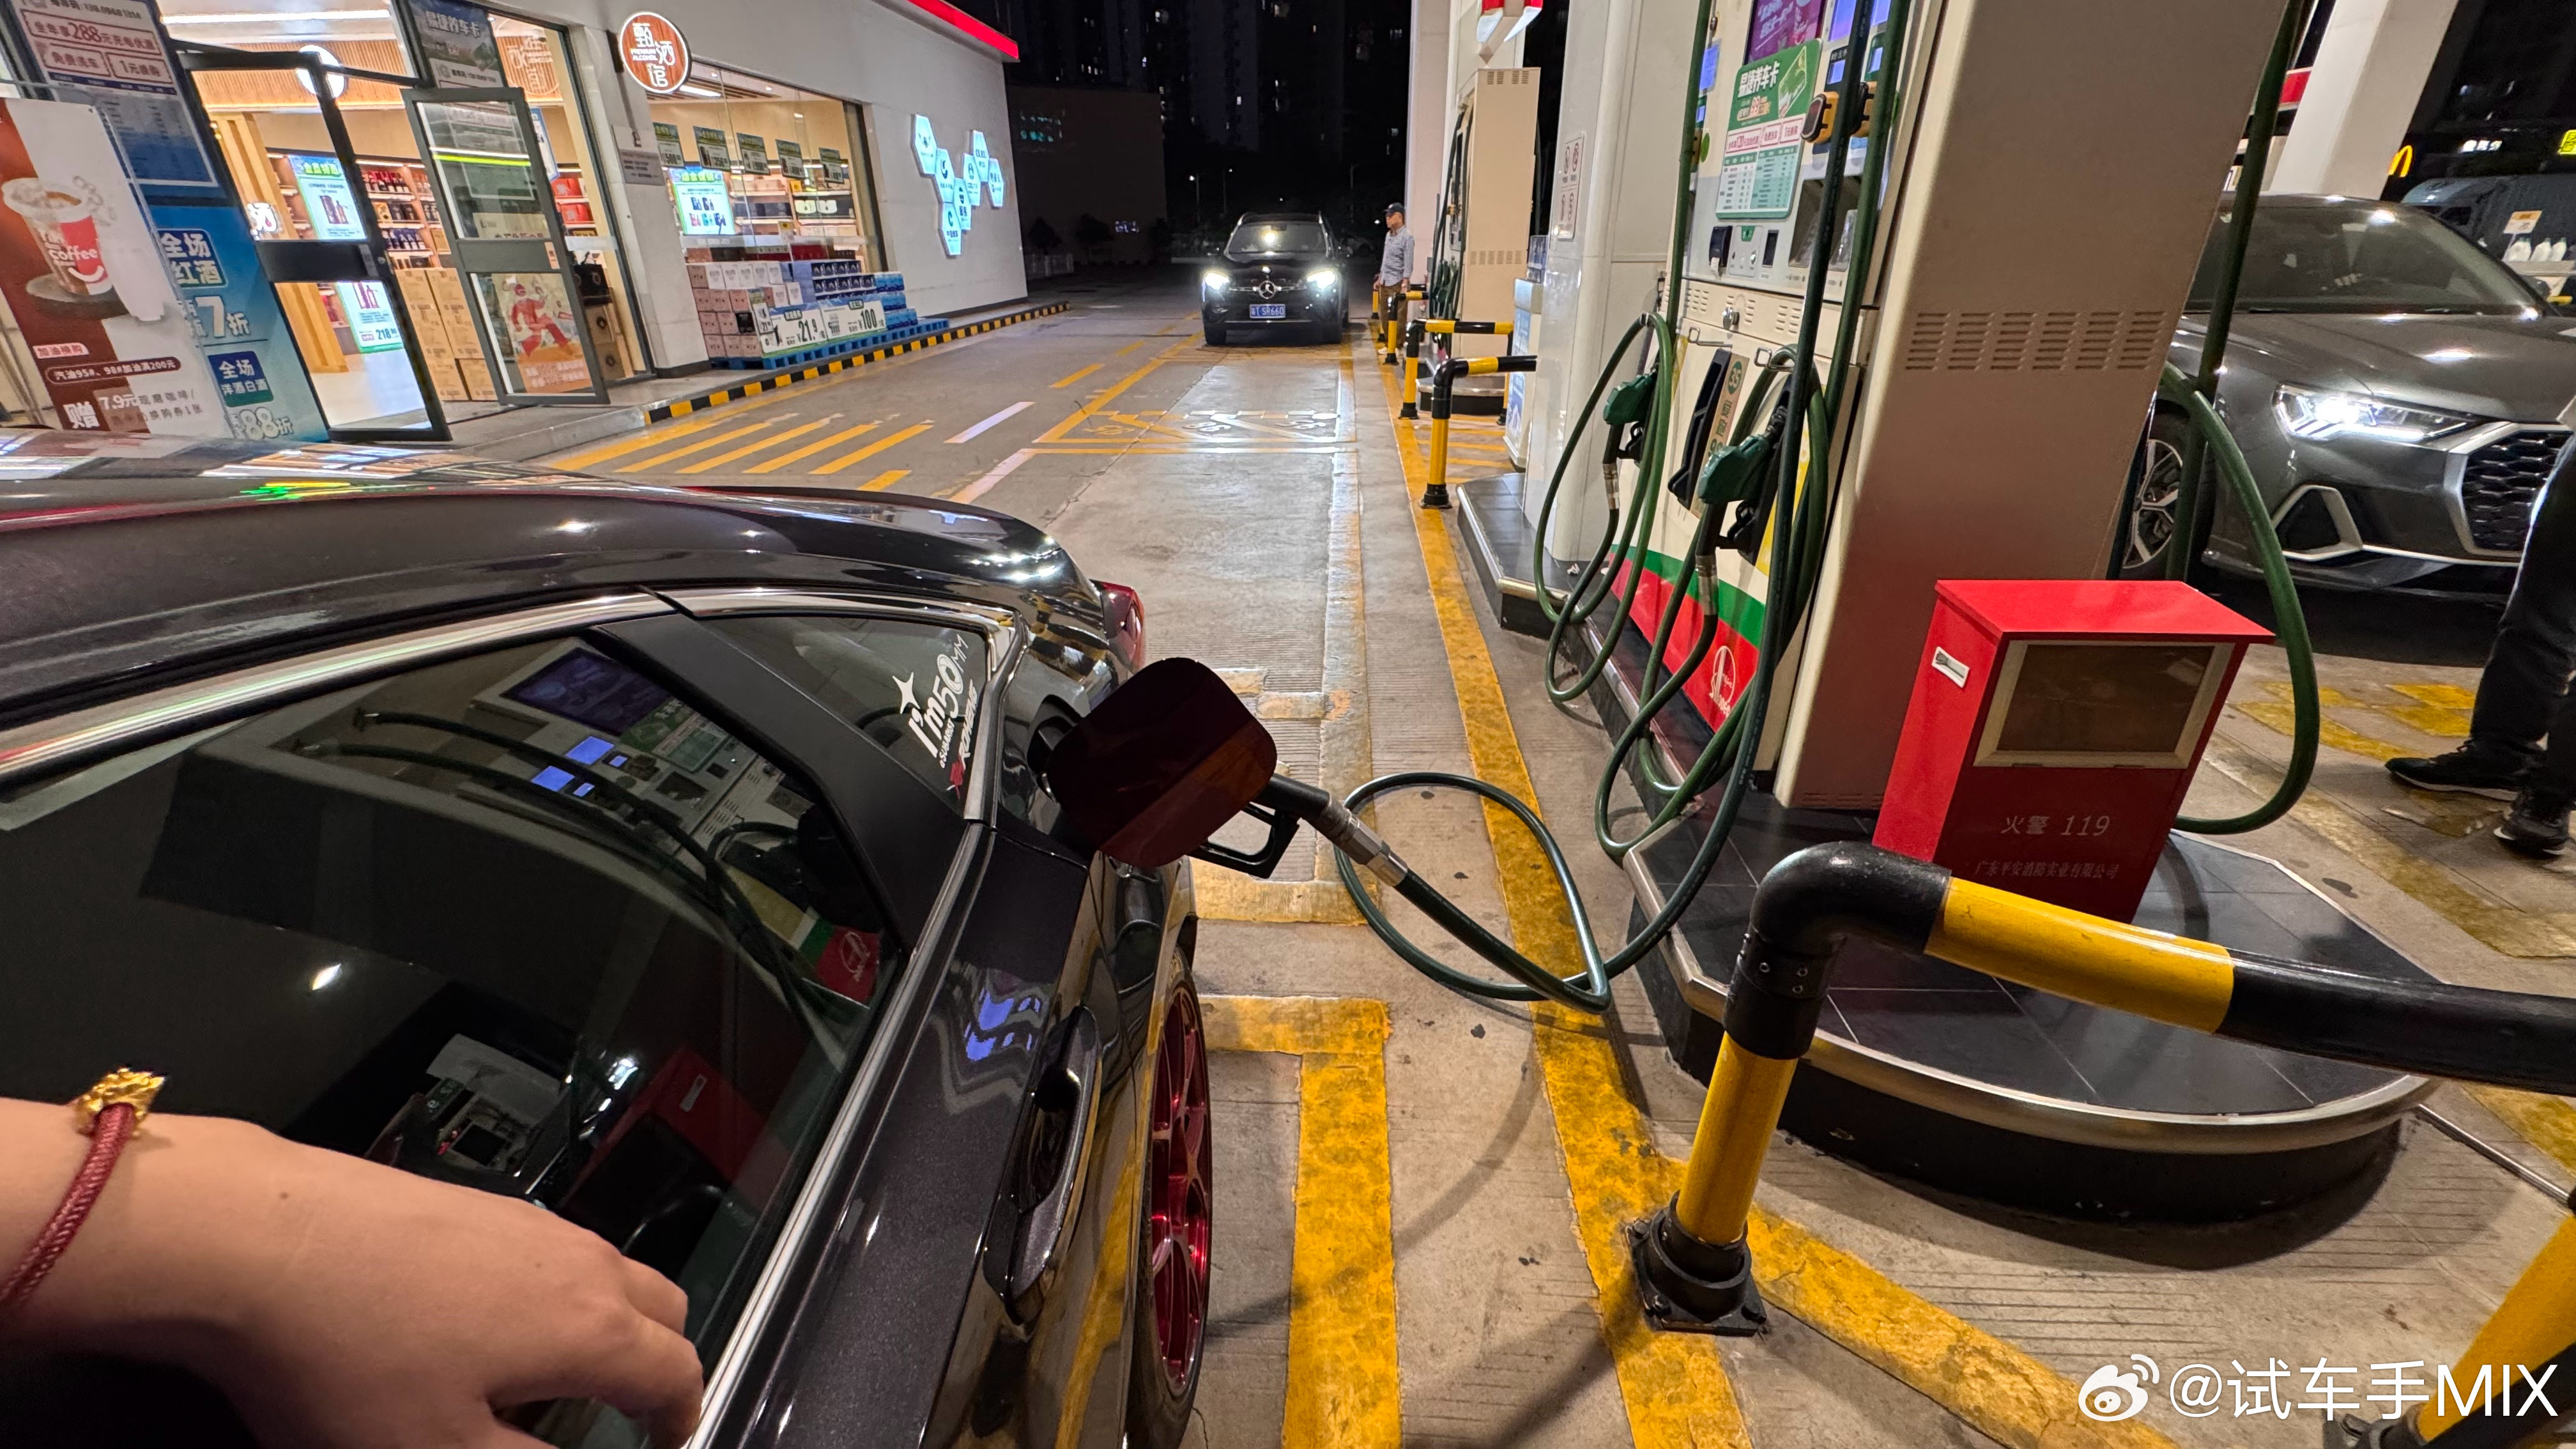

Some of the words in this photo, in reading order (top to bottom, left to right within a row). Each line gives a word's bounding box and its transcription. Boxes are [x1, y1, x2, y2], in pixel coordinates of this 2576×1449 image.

[160, 232, 211, 258] 全场
[171, 259, 223, 285] 红酒
[37, 344, 84, 357] 加油换购
[219, 360, 256, 379] 全场
[221, 379, 268, 395] 洋酒白酒
[63, 401, 100, 429] 赠
[2000, 815, 2050, 834] 火警
[2060, 815, 2111, 836] 119
